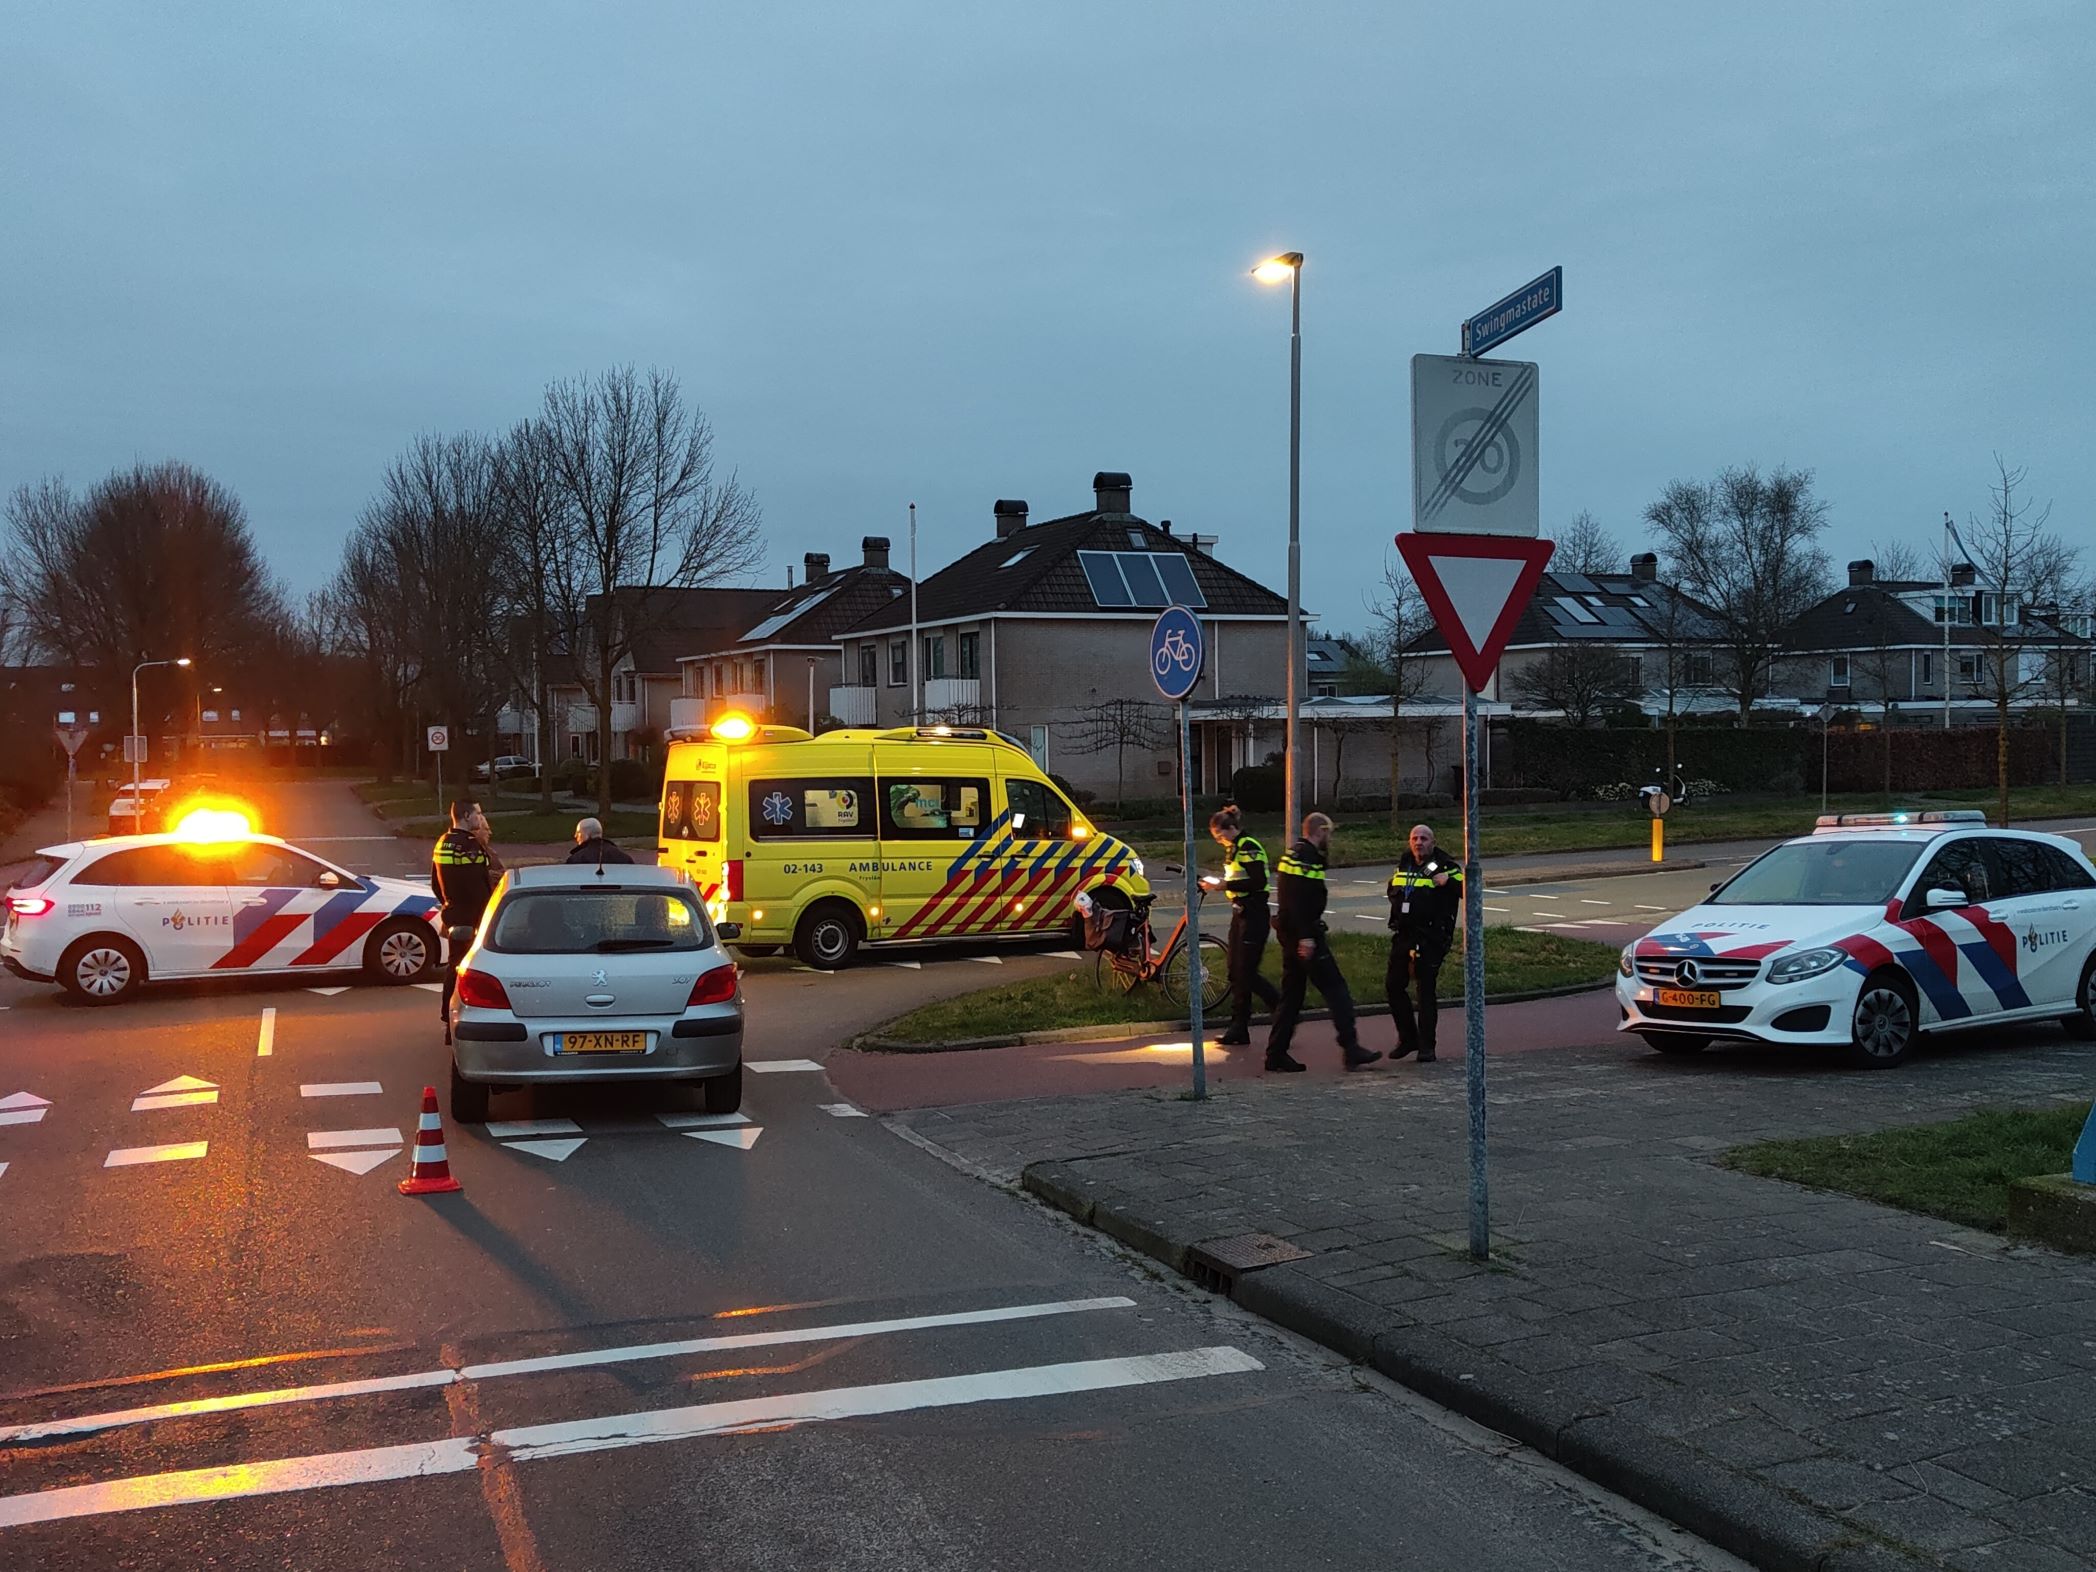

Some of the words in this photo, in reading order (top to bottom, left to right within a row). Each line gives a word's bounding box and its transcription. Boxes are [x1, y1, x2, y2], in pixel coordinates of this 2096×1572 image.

[1475, 287, 1550, 341] Swingmastate
[1453, 370, 1503, 387] ZONE
[783, 863, 824, 874] 02-143
[848, 861, 933, 872] AMBULANCE
[162, 915, 229, 931] POLITIE
[1691, 921, 1772, 930] POLITIE
[2022, 930, 2068, 953] POLITIE
[1661, 992, 1716, 1006] G-400-FG
[567, 1034, 641, 1049] 97-XN-RF
